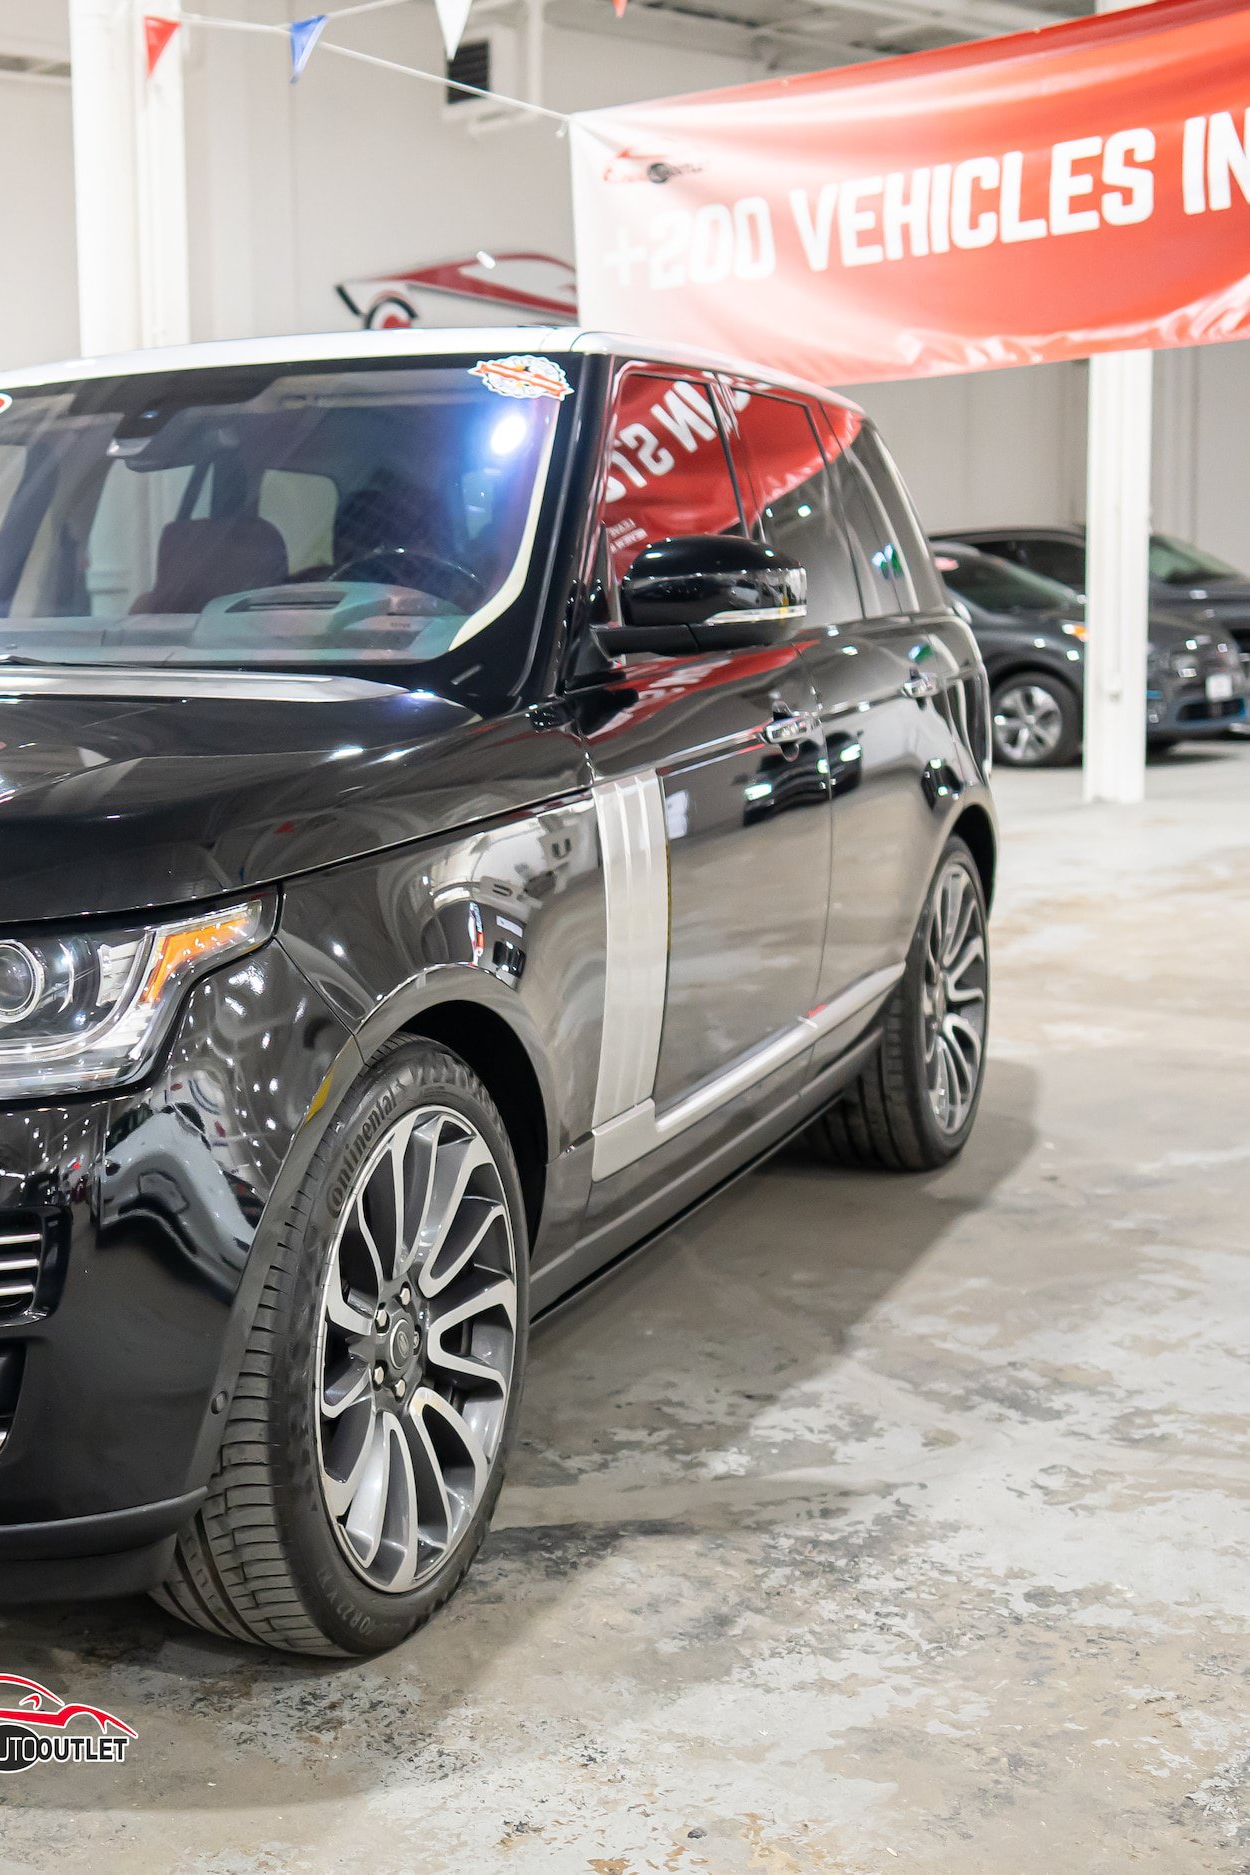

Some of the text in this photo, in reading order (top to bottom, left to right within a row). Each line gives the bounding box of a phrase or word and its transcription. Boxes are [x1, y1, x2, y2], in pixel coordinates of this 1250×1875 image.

[603, 196, 776, 290] +200
[790, 128, 1157, 272] VEHICLES
[326, 1087, 399, 1218] Continental
